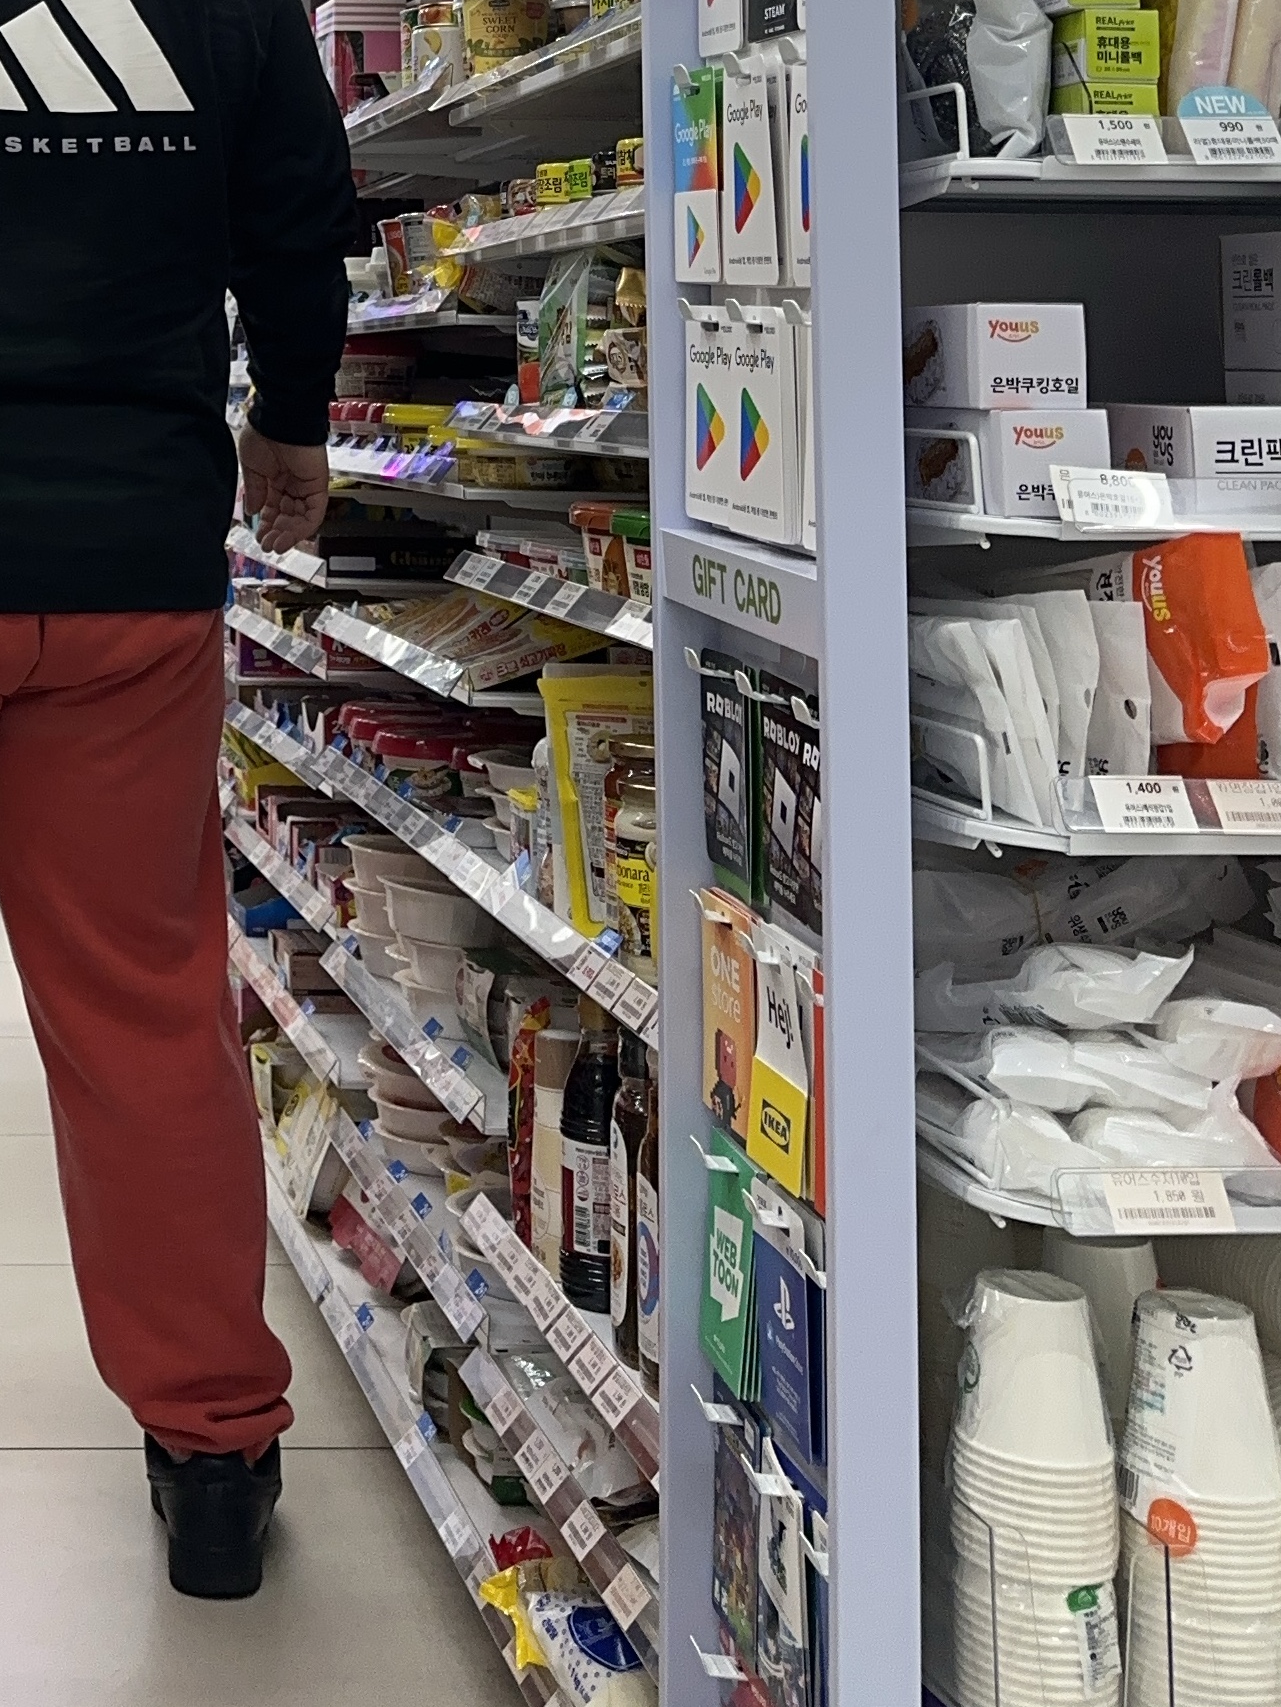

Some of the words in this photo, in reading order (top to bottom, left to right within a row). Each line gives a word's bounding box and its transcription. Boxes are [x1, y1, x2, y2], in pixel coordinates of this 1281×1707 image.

[482, 16, 518, 25] SWEET
[764, 3, 786, 21] STEAM
[1095, 16, 1118, 26] REAL
[486, 25, 516, 34] CORN
[1096, 35, 1130, 50] 휴대용
[1094, 90, 1116, 100] REAL
[1194, 96, 1246, 114] NEW
[726, 102, 749, 126] Google
[749, 101, 763, 126] Play
[675, 118, 697, 147] Google
[1098, 119, 1134, 131] 1,500
[1220, 121, 1244, 132] 990
[689, 344, 715, 368] Google
[716, 347, 732, 371] Play
[735, 347, 759, 373] Google
[760, 350, 775, 375] Play
[990, 376, 1080, 395] 은박쿠킹호일
[1217, 479, 1257, 491] CLEAN
[692, 554, 726, 606] GIFT
[733, 569, 782, 627] CARD
[763, 715, 800, 756] ROBLOX
[1126, 782, 1161, 795] 1,400
[710, 945, 741, 994] ONE
[710, 981, 742, 1024] store
[766, 985, 795, 1050] Hej!
[762, 1107, 790, 1143] IKEA
[716, 1227, 738, 1270] WEB
[712, 1252, 740, 1299] TOON
